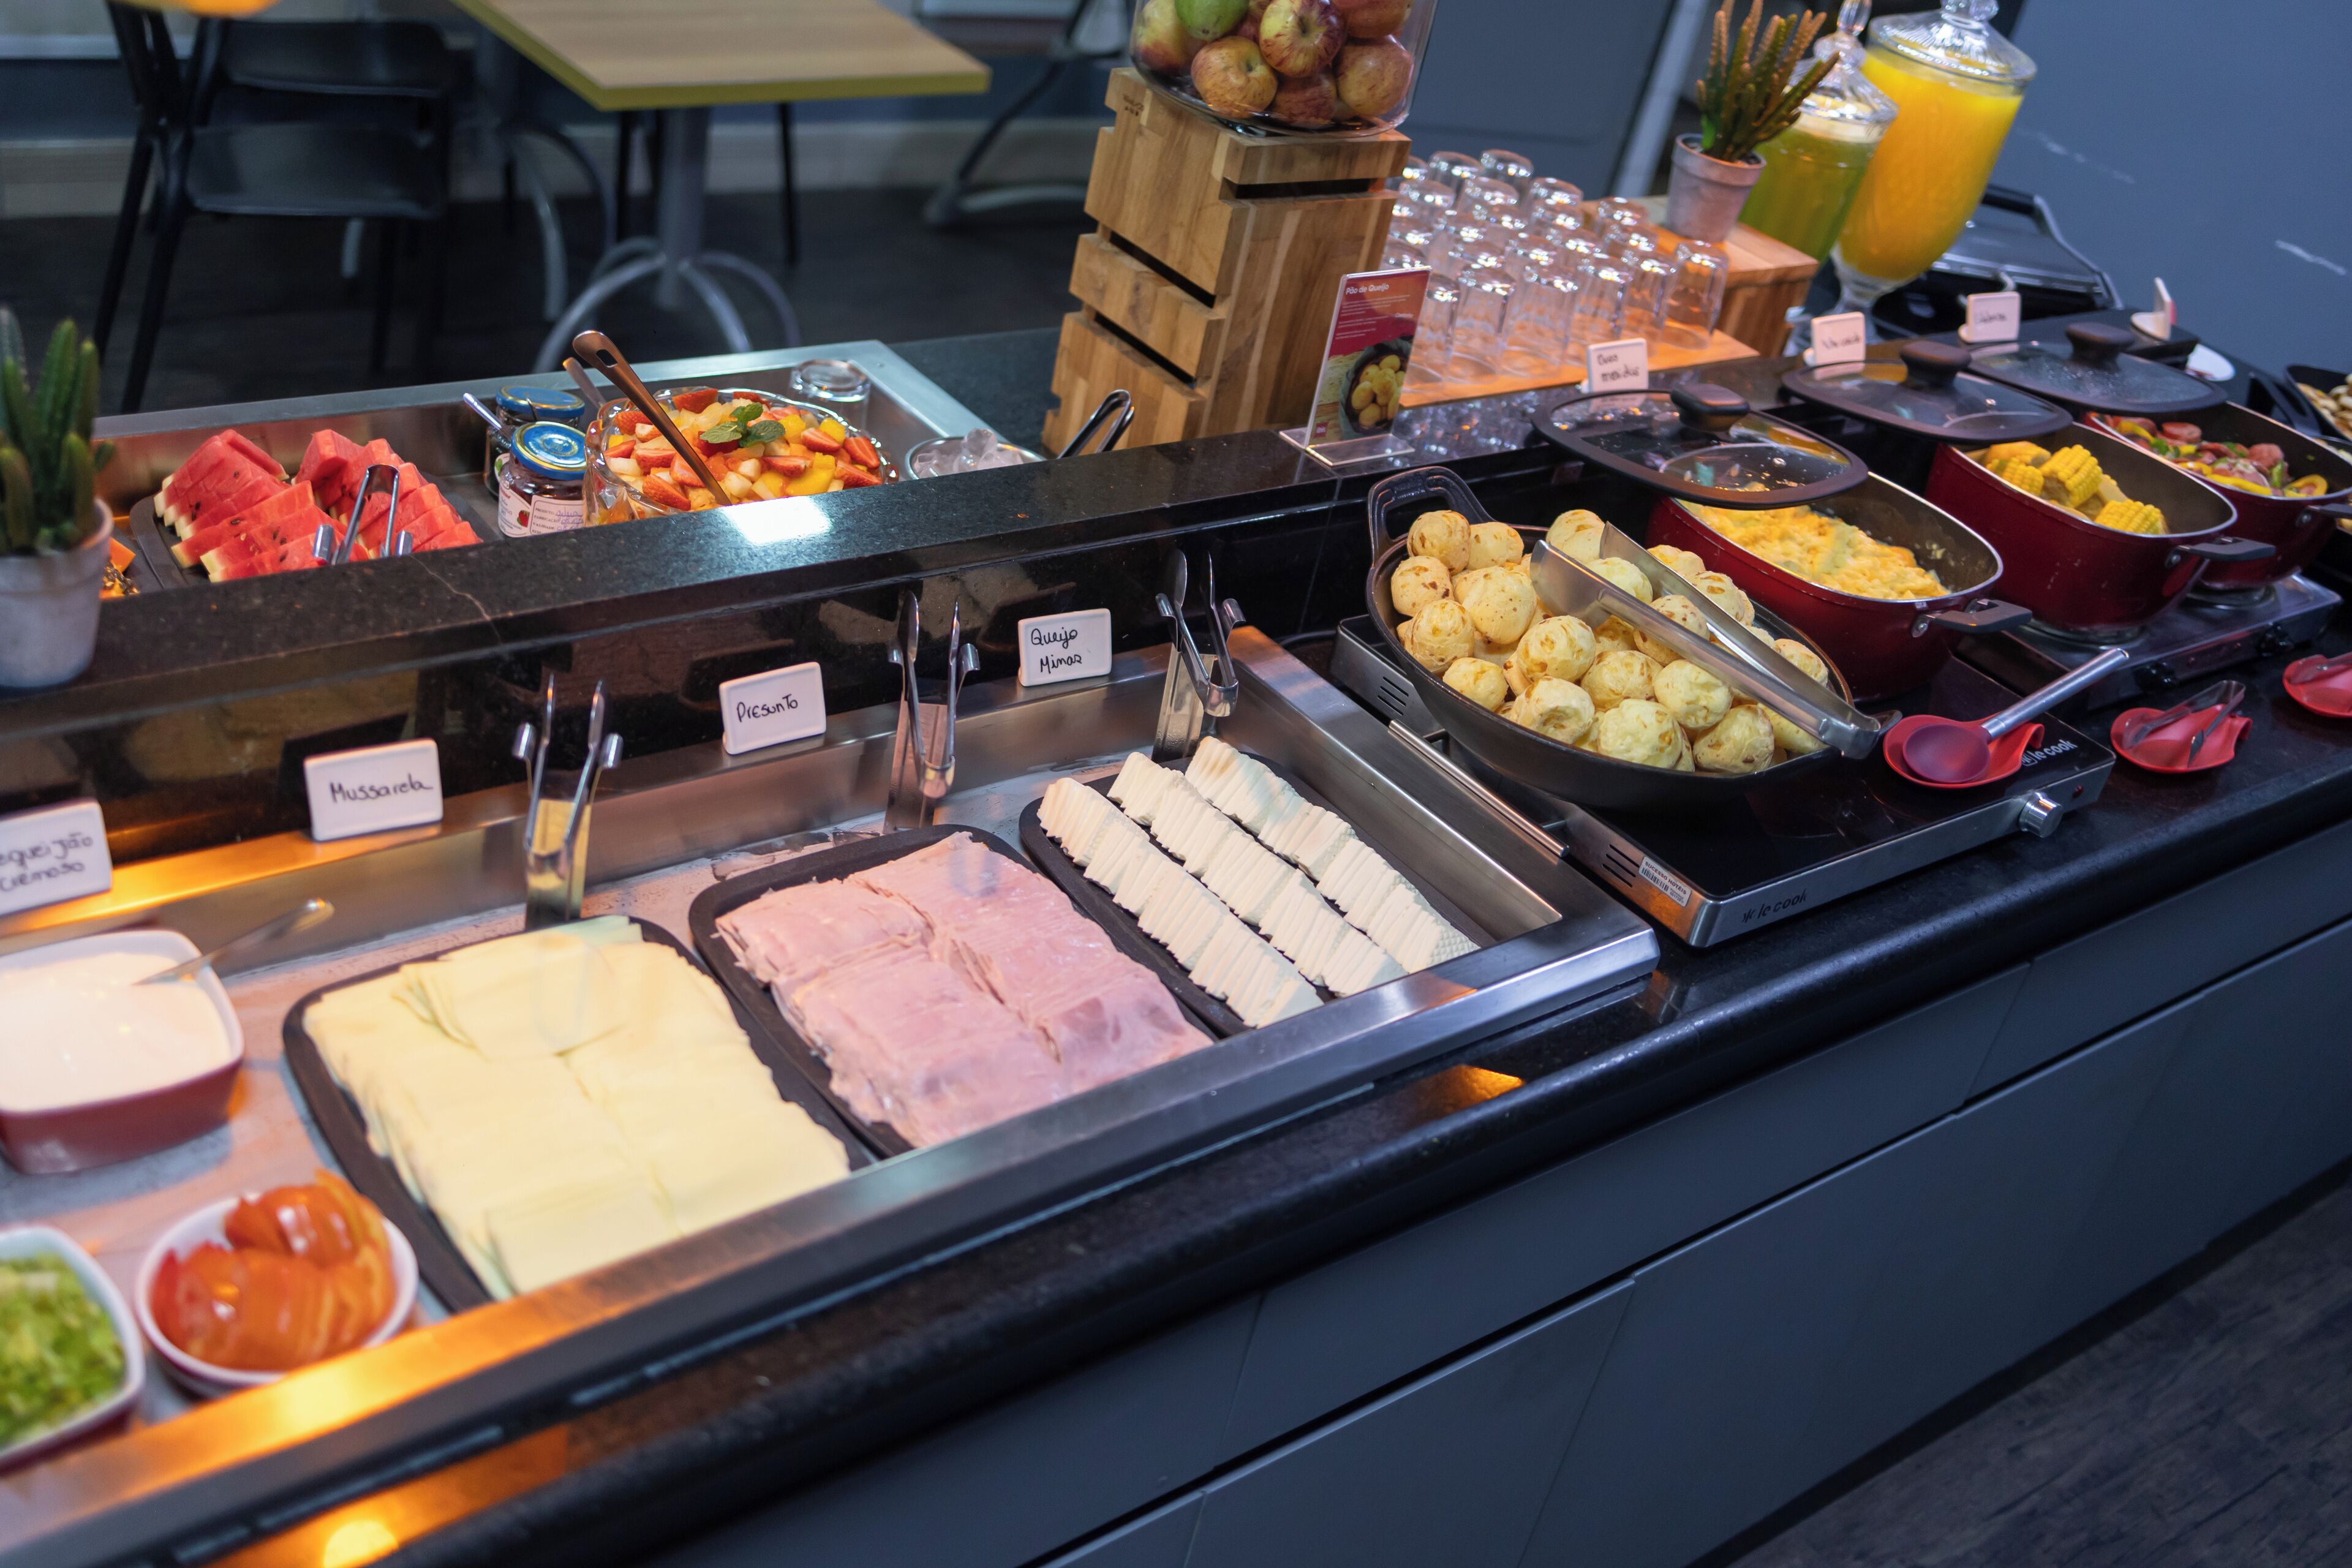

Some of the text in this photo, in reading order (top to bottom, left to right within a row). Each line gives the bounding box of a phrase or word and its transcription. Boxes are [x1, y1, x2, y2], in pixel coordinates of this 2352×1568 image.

[1346, 286, 1358, 295] Pão
[1368, 283, 1390, 292] Queijo
[1031, 627, 1078, 649] Queijo
[1040, 654, 1082, 674] Minas
[2043, 739, 2078, 756] cook
[330, 773, 434, 804] Mussarela
[1645, 861, 1668, 881] SUCESSO
[1668, 878, 1687, 895] HOTÉIS
[1773, 889, 1807, 913] cook
